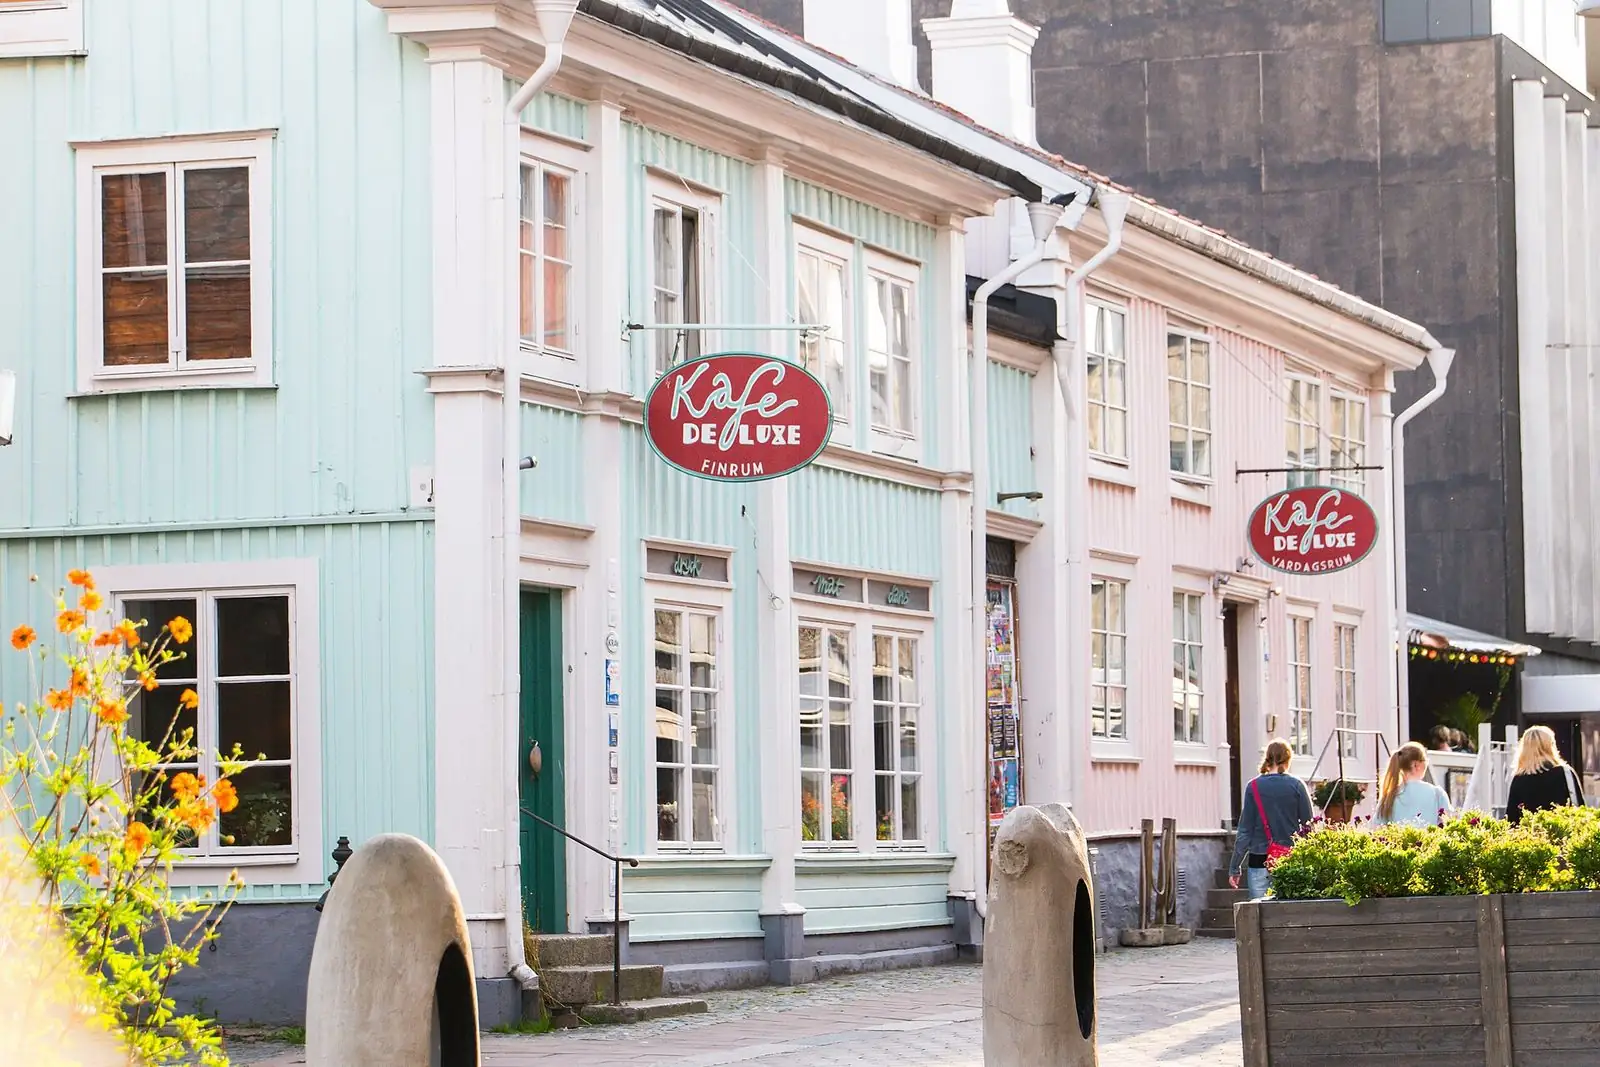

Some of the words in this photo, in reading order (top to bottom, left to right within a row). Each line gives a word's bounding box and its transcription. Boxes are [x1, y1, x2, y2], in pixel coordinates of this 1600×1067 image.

[671, 362, 798, 451] Kafe
[682, 423, 717, 445] DE
[739, 423, 801, 445] LUXE
[701, 459, 764, 477] FINRUM
[1264, 489, 1354, 555] Kafe
[1274, 535, 1299, 552] DE
[1313, 532, 1356, 549] LUXE
[1271, 554, 1353, 574] VARDAGSRUM
